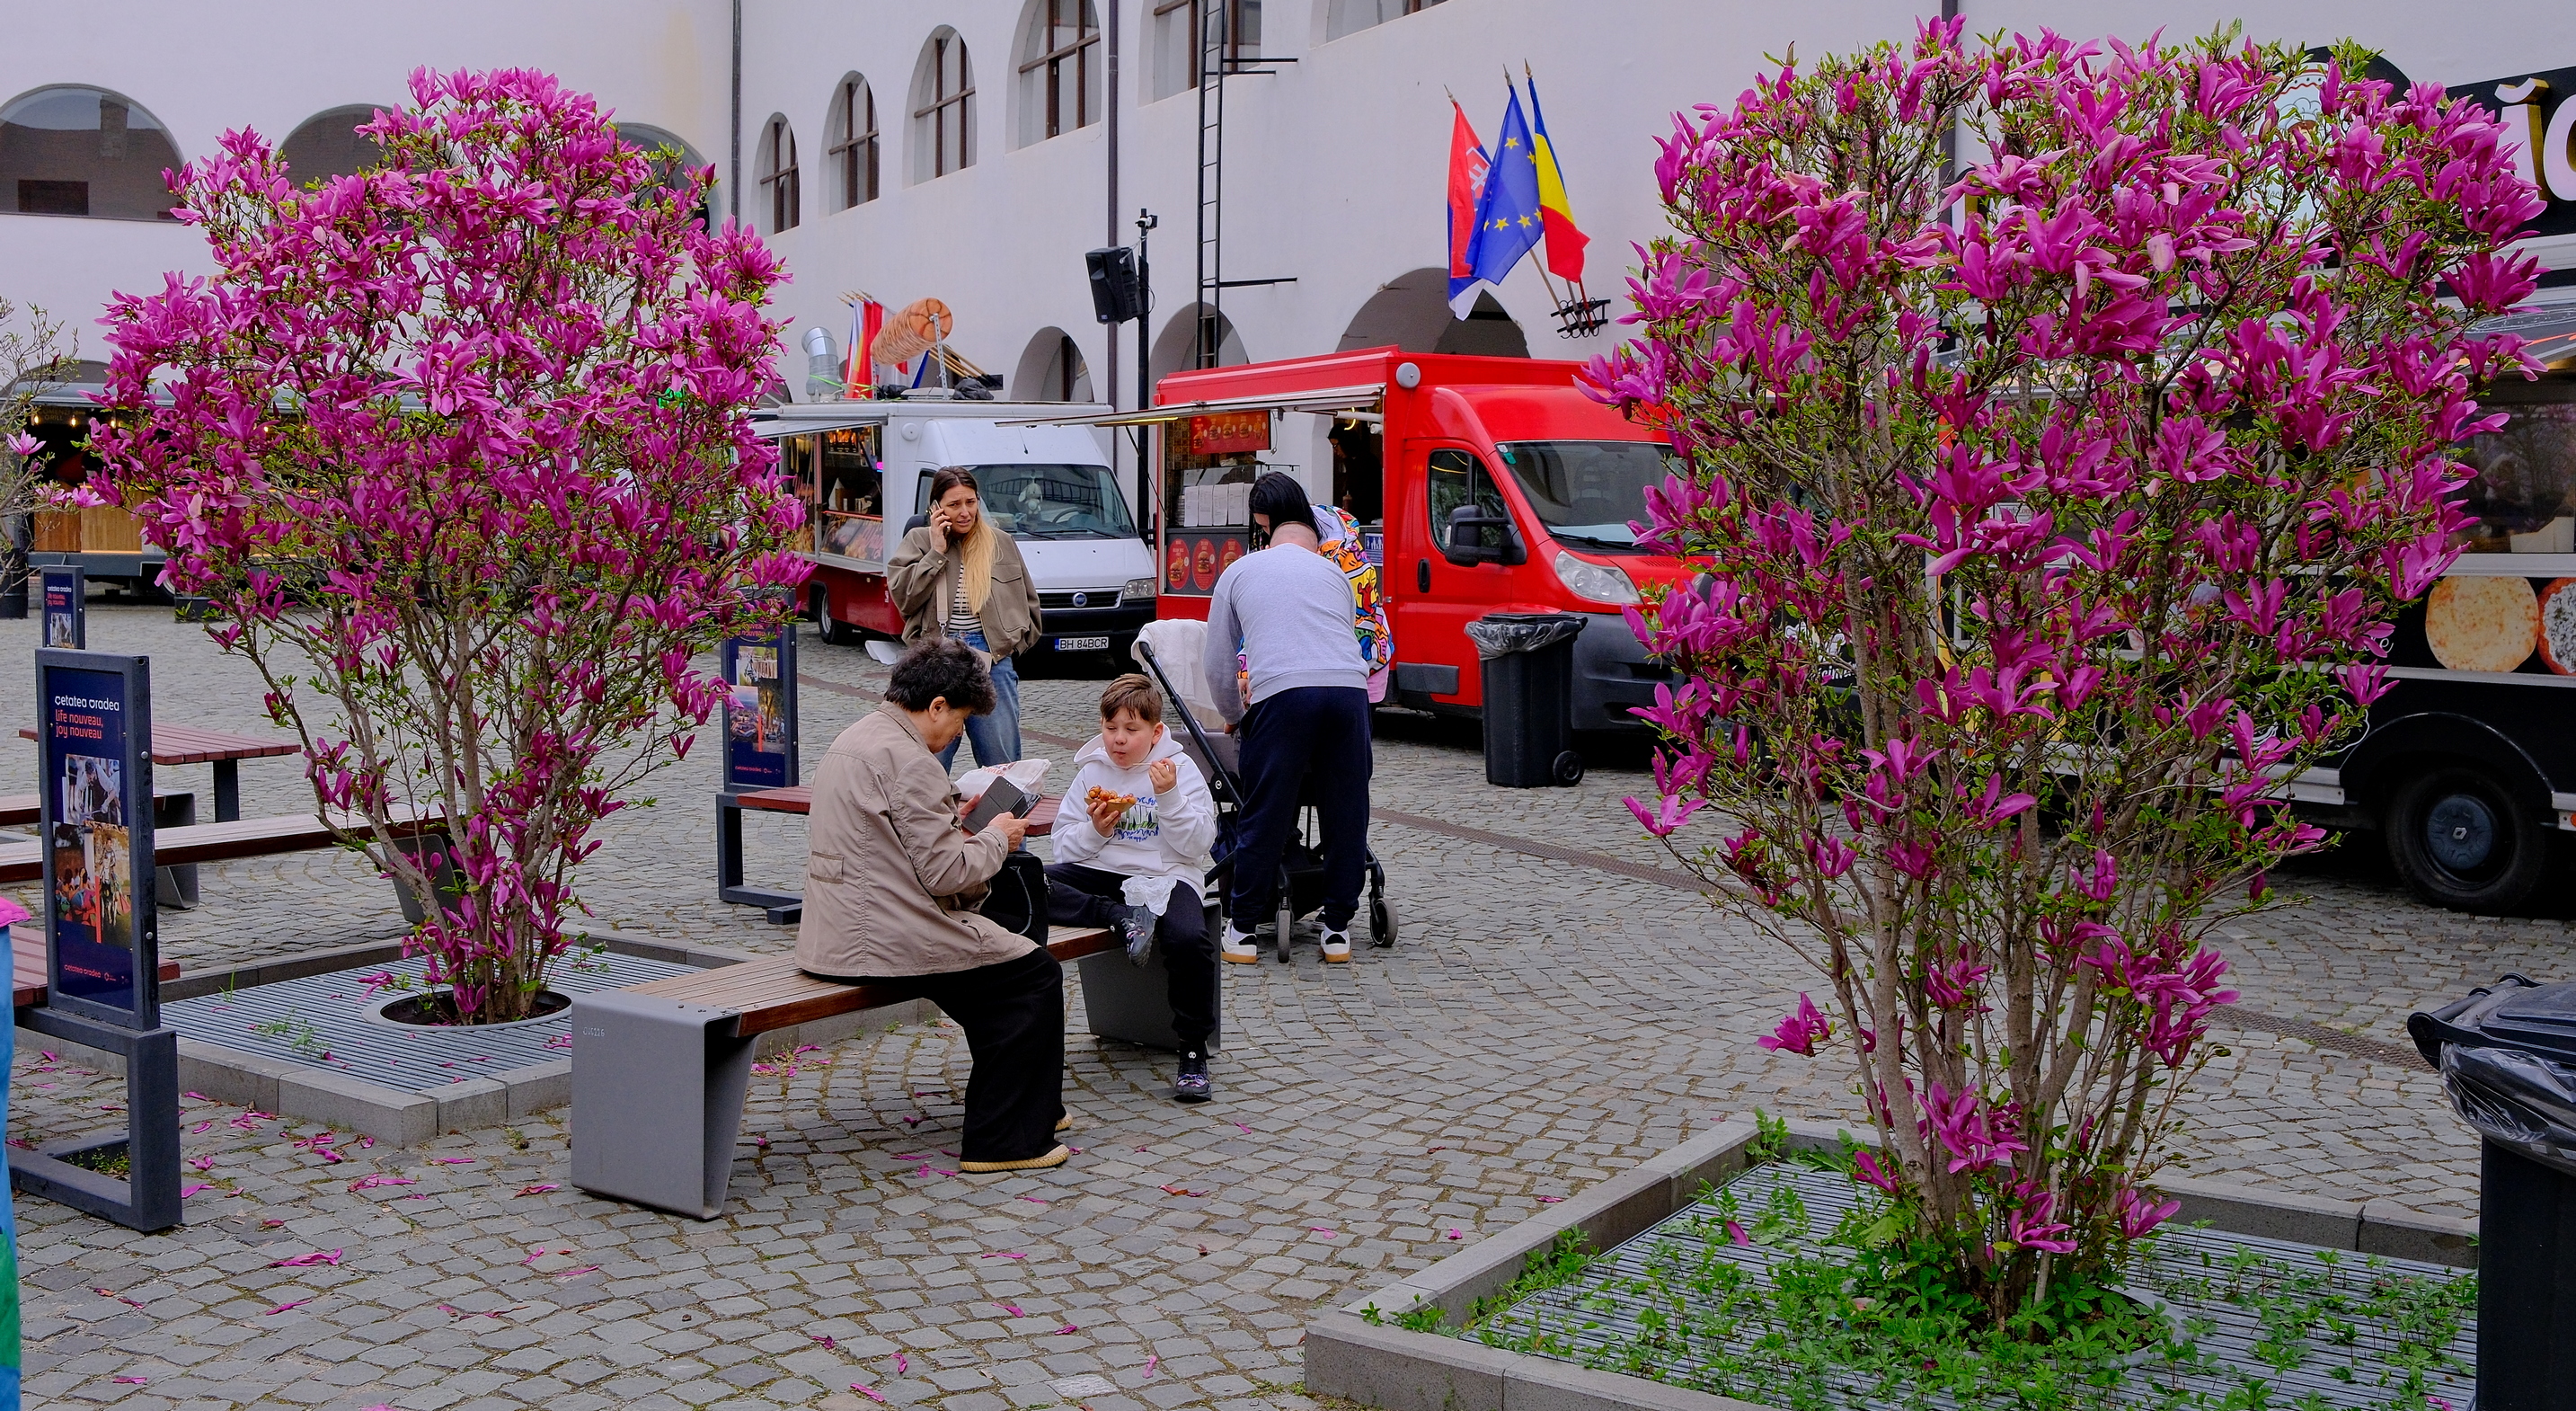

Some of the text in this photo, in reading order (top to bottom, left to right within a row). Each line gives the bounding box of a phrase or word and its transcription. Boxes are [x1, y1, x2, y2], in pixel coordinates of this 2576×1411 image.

[1060, 639, 1074, 649] BH
[54, 695, 120, 712] cetatea oradea
[55, 708, 104, 728] life nouveau,
[56, 722, 68, 739] joy
[69, 726, 102, 739] nouveau
